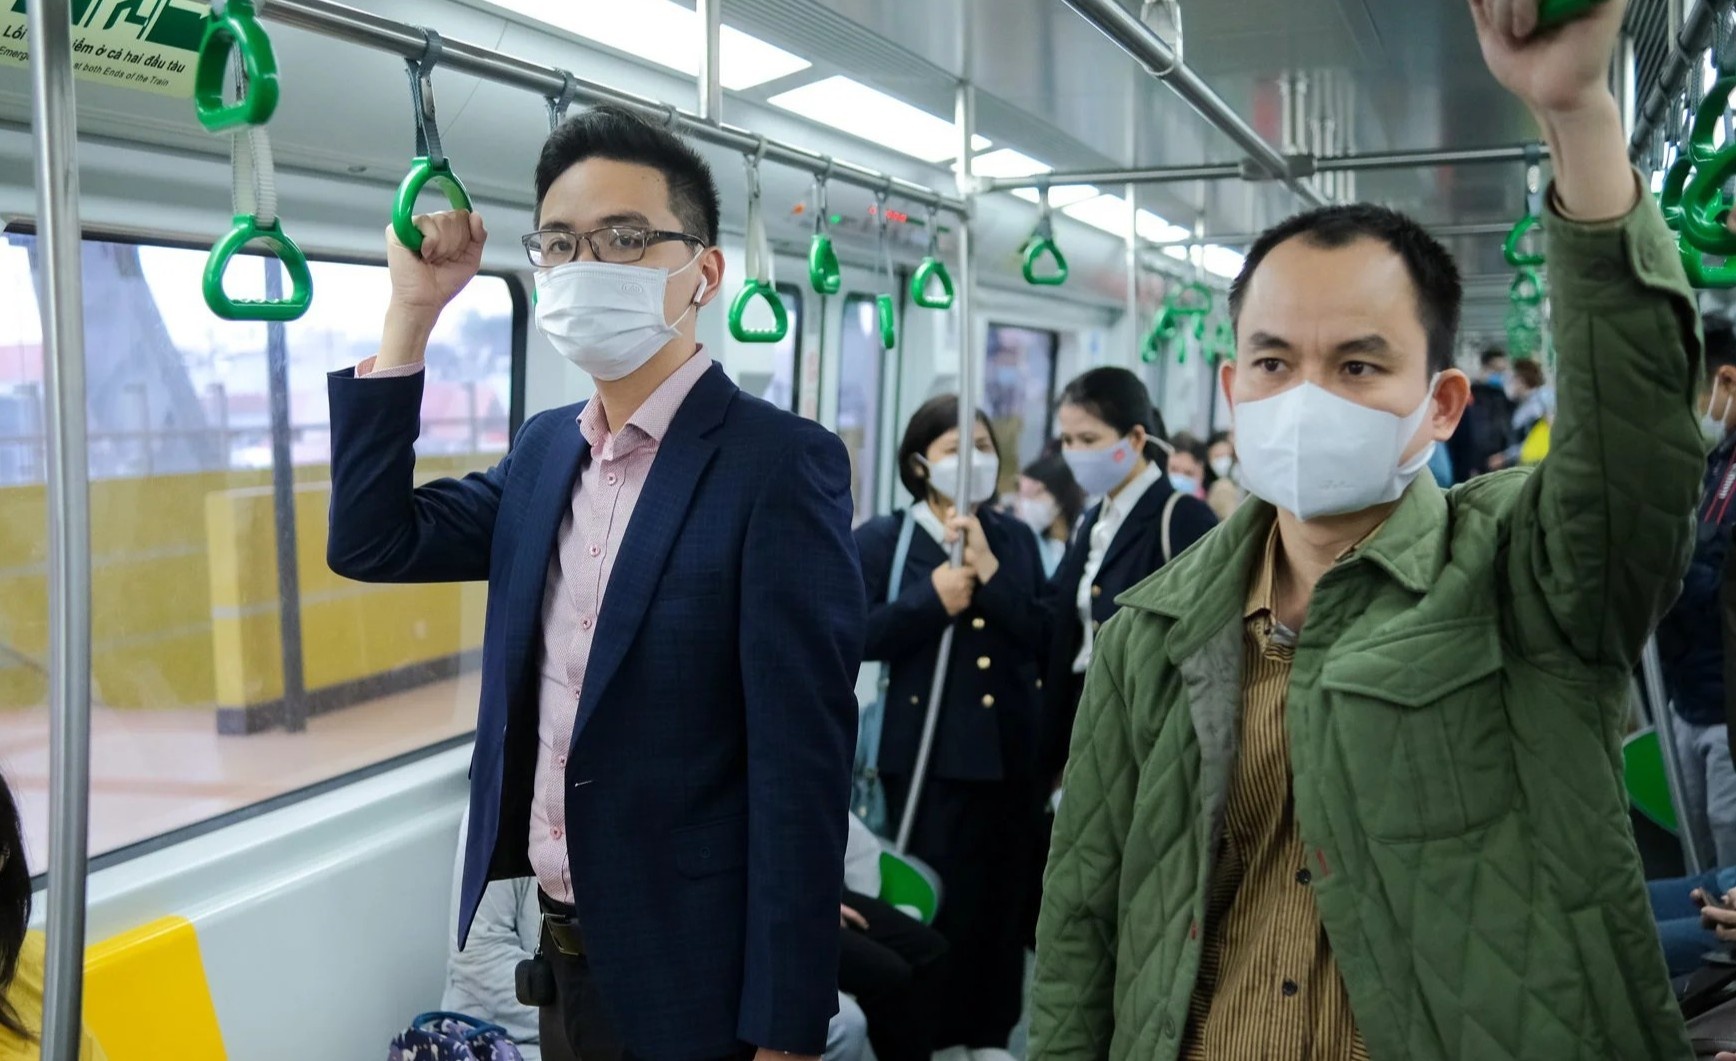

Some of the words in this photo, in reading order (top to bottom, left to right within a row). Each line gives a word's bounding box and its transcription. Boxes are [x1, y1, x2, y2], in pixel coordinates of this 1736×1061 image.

[3, 24, 27, 40] Lối
[72, 37, 94, 54] iểm
[95, 44, 107, 56] ở
[107, 48, 124, 60] cả
[123, 50, 144, 64] hai
[144, 54, 166, 69] đầu
[167, 60, 186, 73] tàu
[83, 63, 102, 74] both
[102, 67, 125, 78] Ends
[125, 72, 136, 80] of
[136, 73, 149, 83] the
[150, 75, 169, 87] Train
